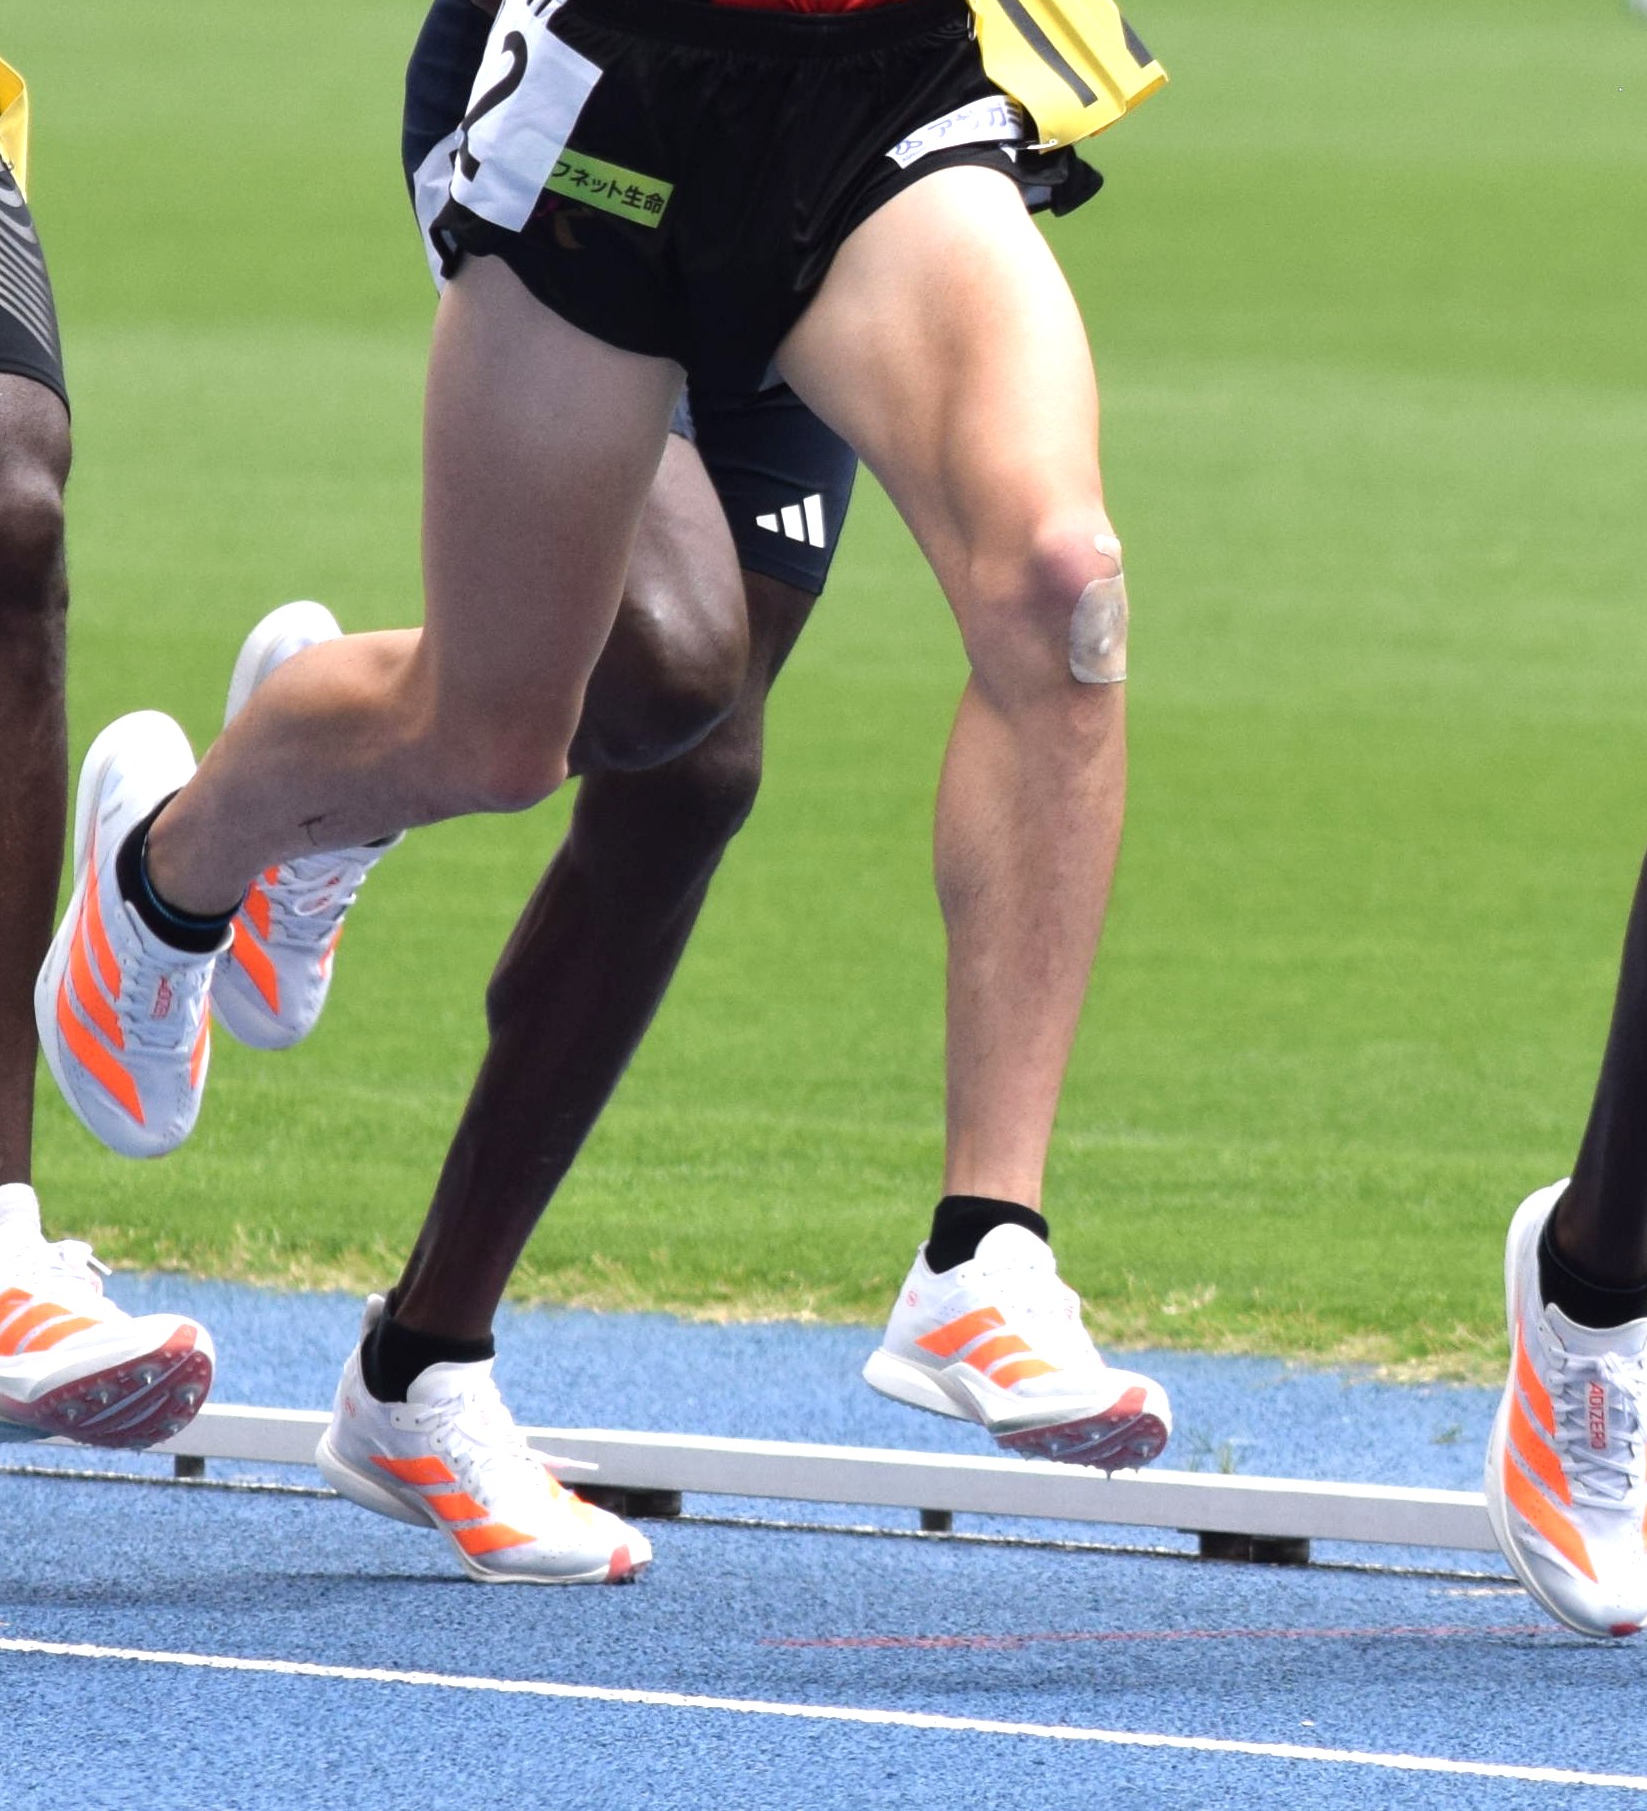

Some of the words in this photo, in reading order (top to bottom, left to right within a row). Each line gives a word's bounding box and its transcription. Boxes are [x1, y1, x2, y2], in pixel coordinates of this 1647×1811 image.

[551, 159, 666, 215] フネット生命
